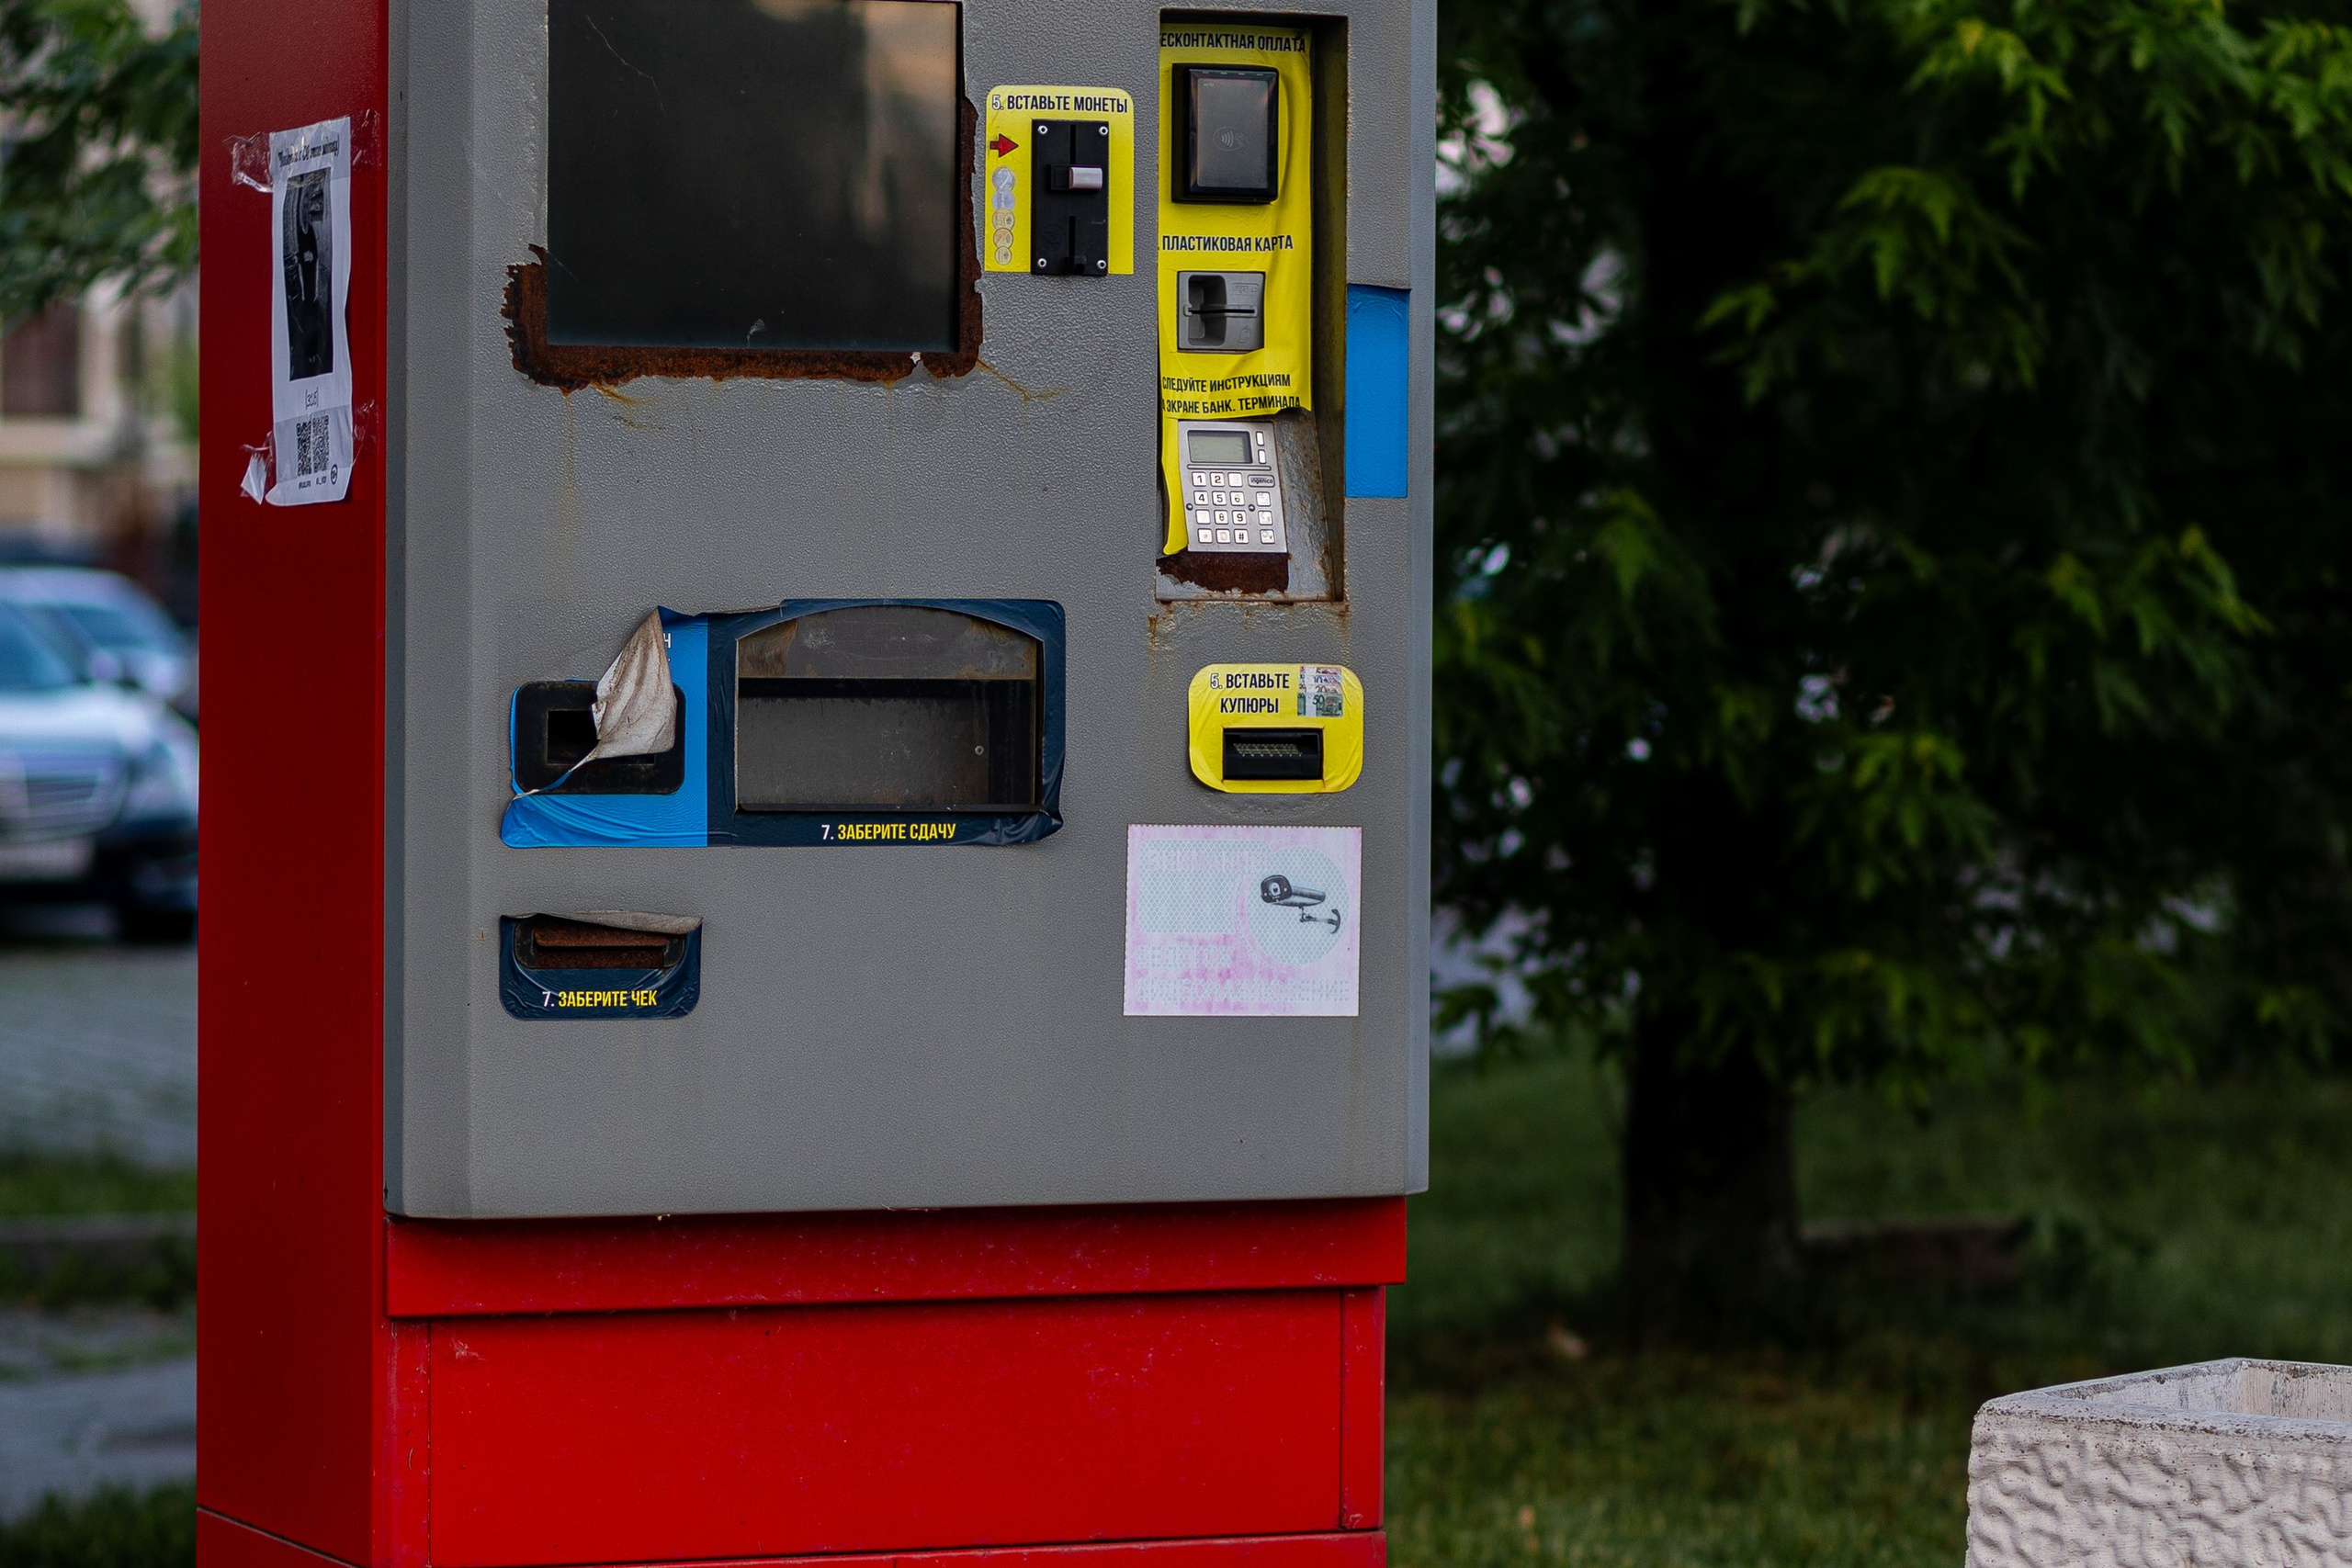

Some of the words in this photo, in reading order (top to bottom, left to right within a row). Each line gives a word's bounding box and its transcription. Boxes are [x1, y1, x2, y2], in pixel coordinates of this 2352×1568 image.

[1159, 32, 1255, 50] ЕСКОНТАКТНАЯ
[1258, 36, 1306, 53] ОПЛАТА
[991, 95, 1004, 110] 5.
[1007, 95, 1070, 111] ВСТАВЬТЕ
[1073, 96, 1128, 113] МОНЕТЫ
[1162, 235, 1251, 252] ПЛАСТИКОВАЯ
[1255, 234, 1294, 252] КАРТА
[1162, 376, 1207, 393] СЛЕДУЙТЕ
[1210, 374, 1291, 392] ИНСТРУКЦИЯМ
[1166, 399, 1200, 413] ЭКРАНЕ
[1202, 399, 1236, 413] БАНК.
[1238, 396, 1301, 411] ТЕРМИНАЛА
[1196, 475, 1203, 484] 1
[1214, 475, 1222, 484] 2
[1198, 493, 1205, 502] 4
[1216, 494, 1224, 502] 5
[1236, 513, 1243, 522] 9
[1210, 672, 1223, 689] 5.
[1226, 673, 1290, 689] ВСТАВЬТЕ
[1220, 697, 1279, 714] КУПЮРЫ
[1312, 694, 1325, 705] 50
[821, 824, 834, 840] 7.
[837, 824, 907, 840] ЗАБЕРИТЕ
[910, 823, 956, 841] СДАЧУ
[542, 990, 555, 1007] 7.
[558, 990, 628, 1008] ЗАБЕРИТЕ
[630, 989, 658, 1007] ЧЕК
